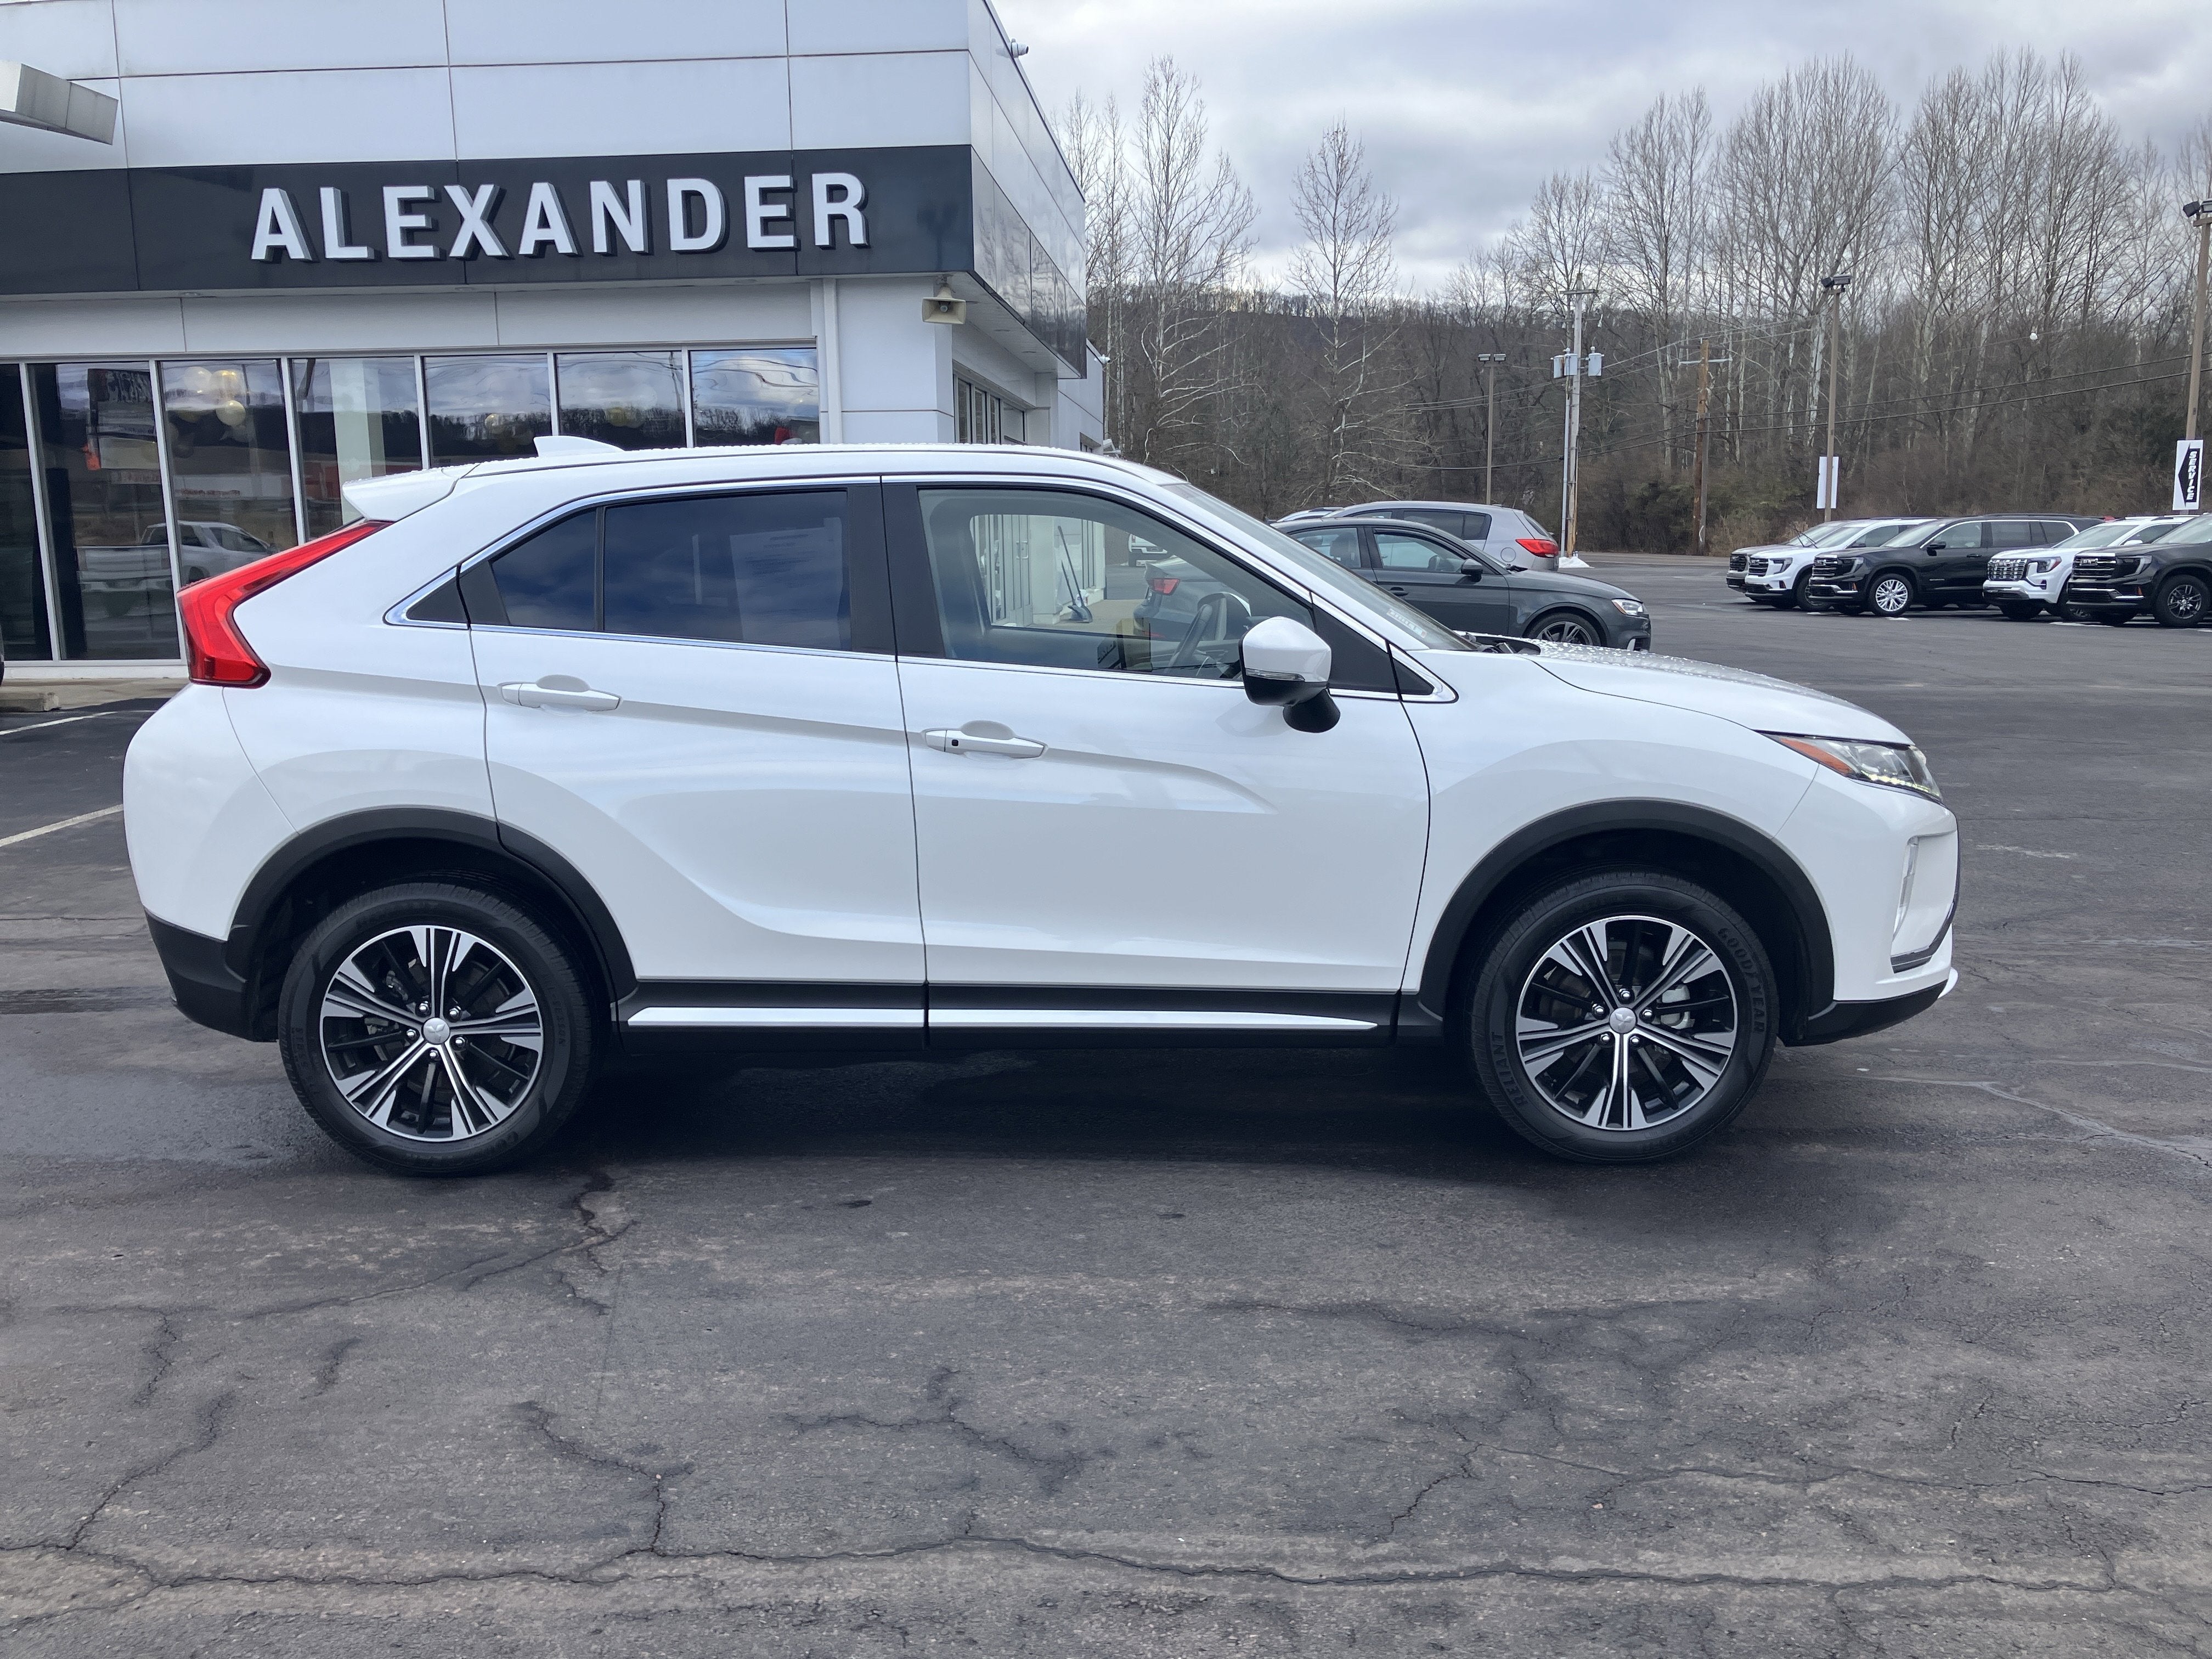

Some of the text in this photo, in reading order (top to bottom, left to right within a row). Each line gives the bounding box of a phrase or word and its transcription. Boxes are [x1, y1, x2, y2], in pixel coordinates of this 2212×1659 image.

[251, 172, 870, 262] ALEXANDER
[2186, 450, 2198, 500] SERVICE
[1717, 927, 1767, 1034] GOODYEAR
[1490, 1031, 1528, 1108] RELIANT
